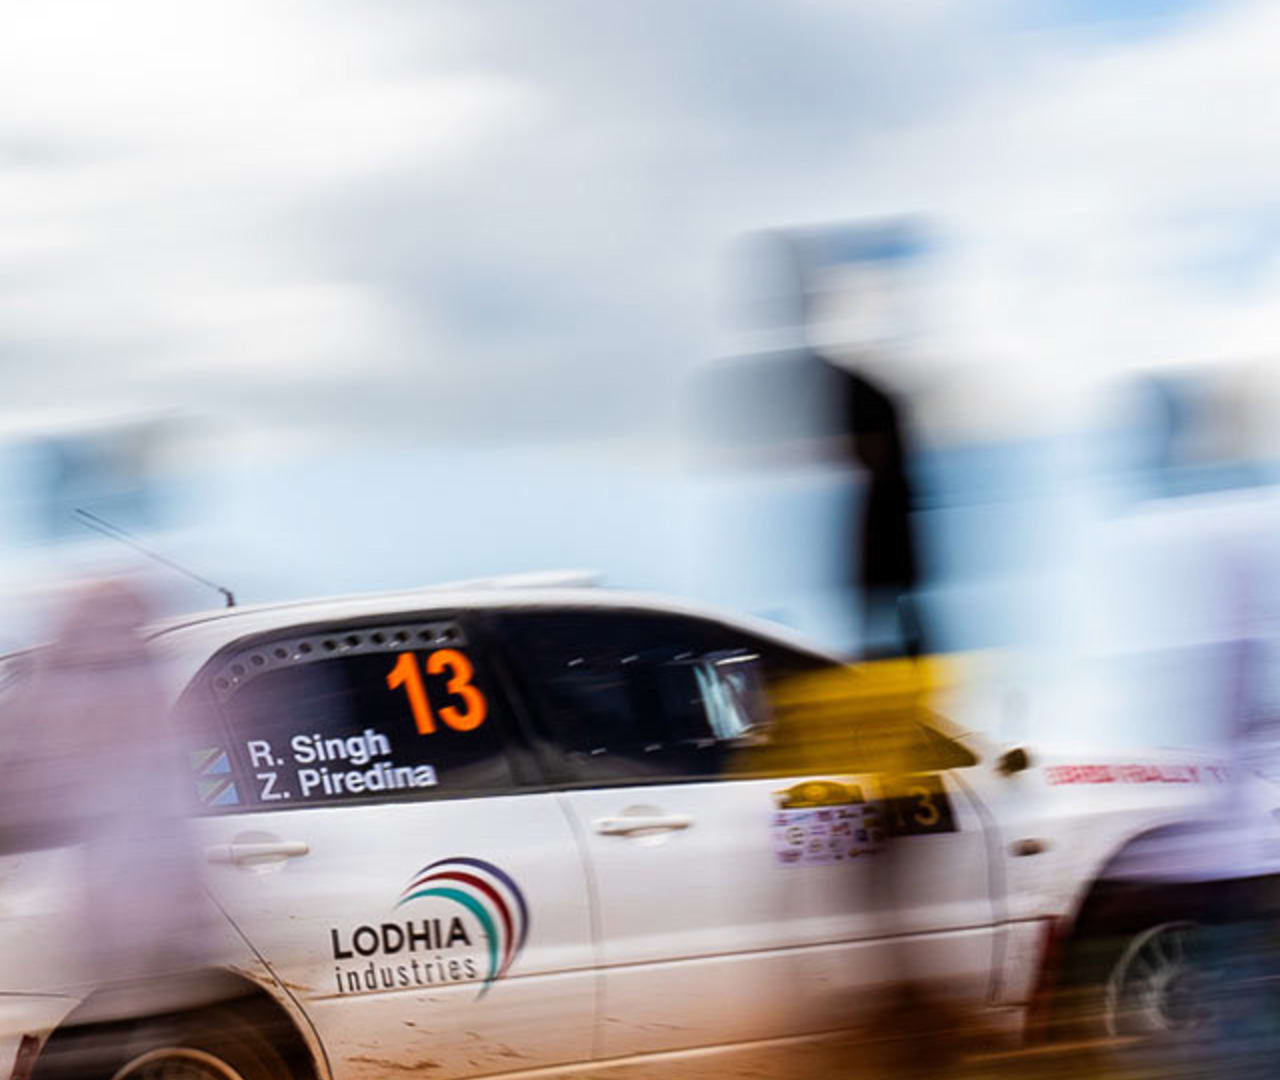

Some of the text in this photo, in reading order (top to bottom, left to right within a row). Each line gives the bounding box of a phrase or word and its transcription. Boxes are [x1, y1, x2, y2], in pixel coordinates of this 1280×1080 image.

[386, 648, 488, 736] 13
[247, 728, 392, 768] R. Singh
[257, 761, 439, 801] Z. Piredina
[331, 916, 472, 960] LODHIA
[335, 955, 477, 994] industries
